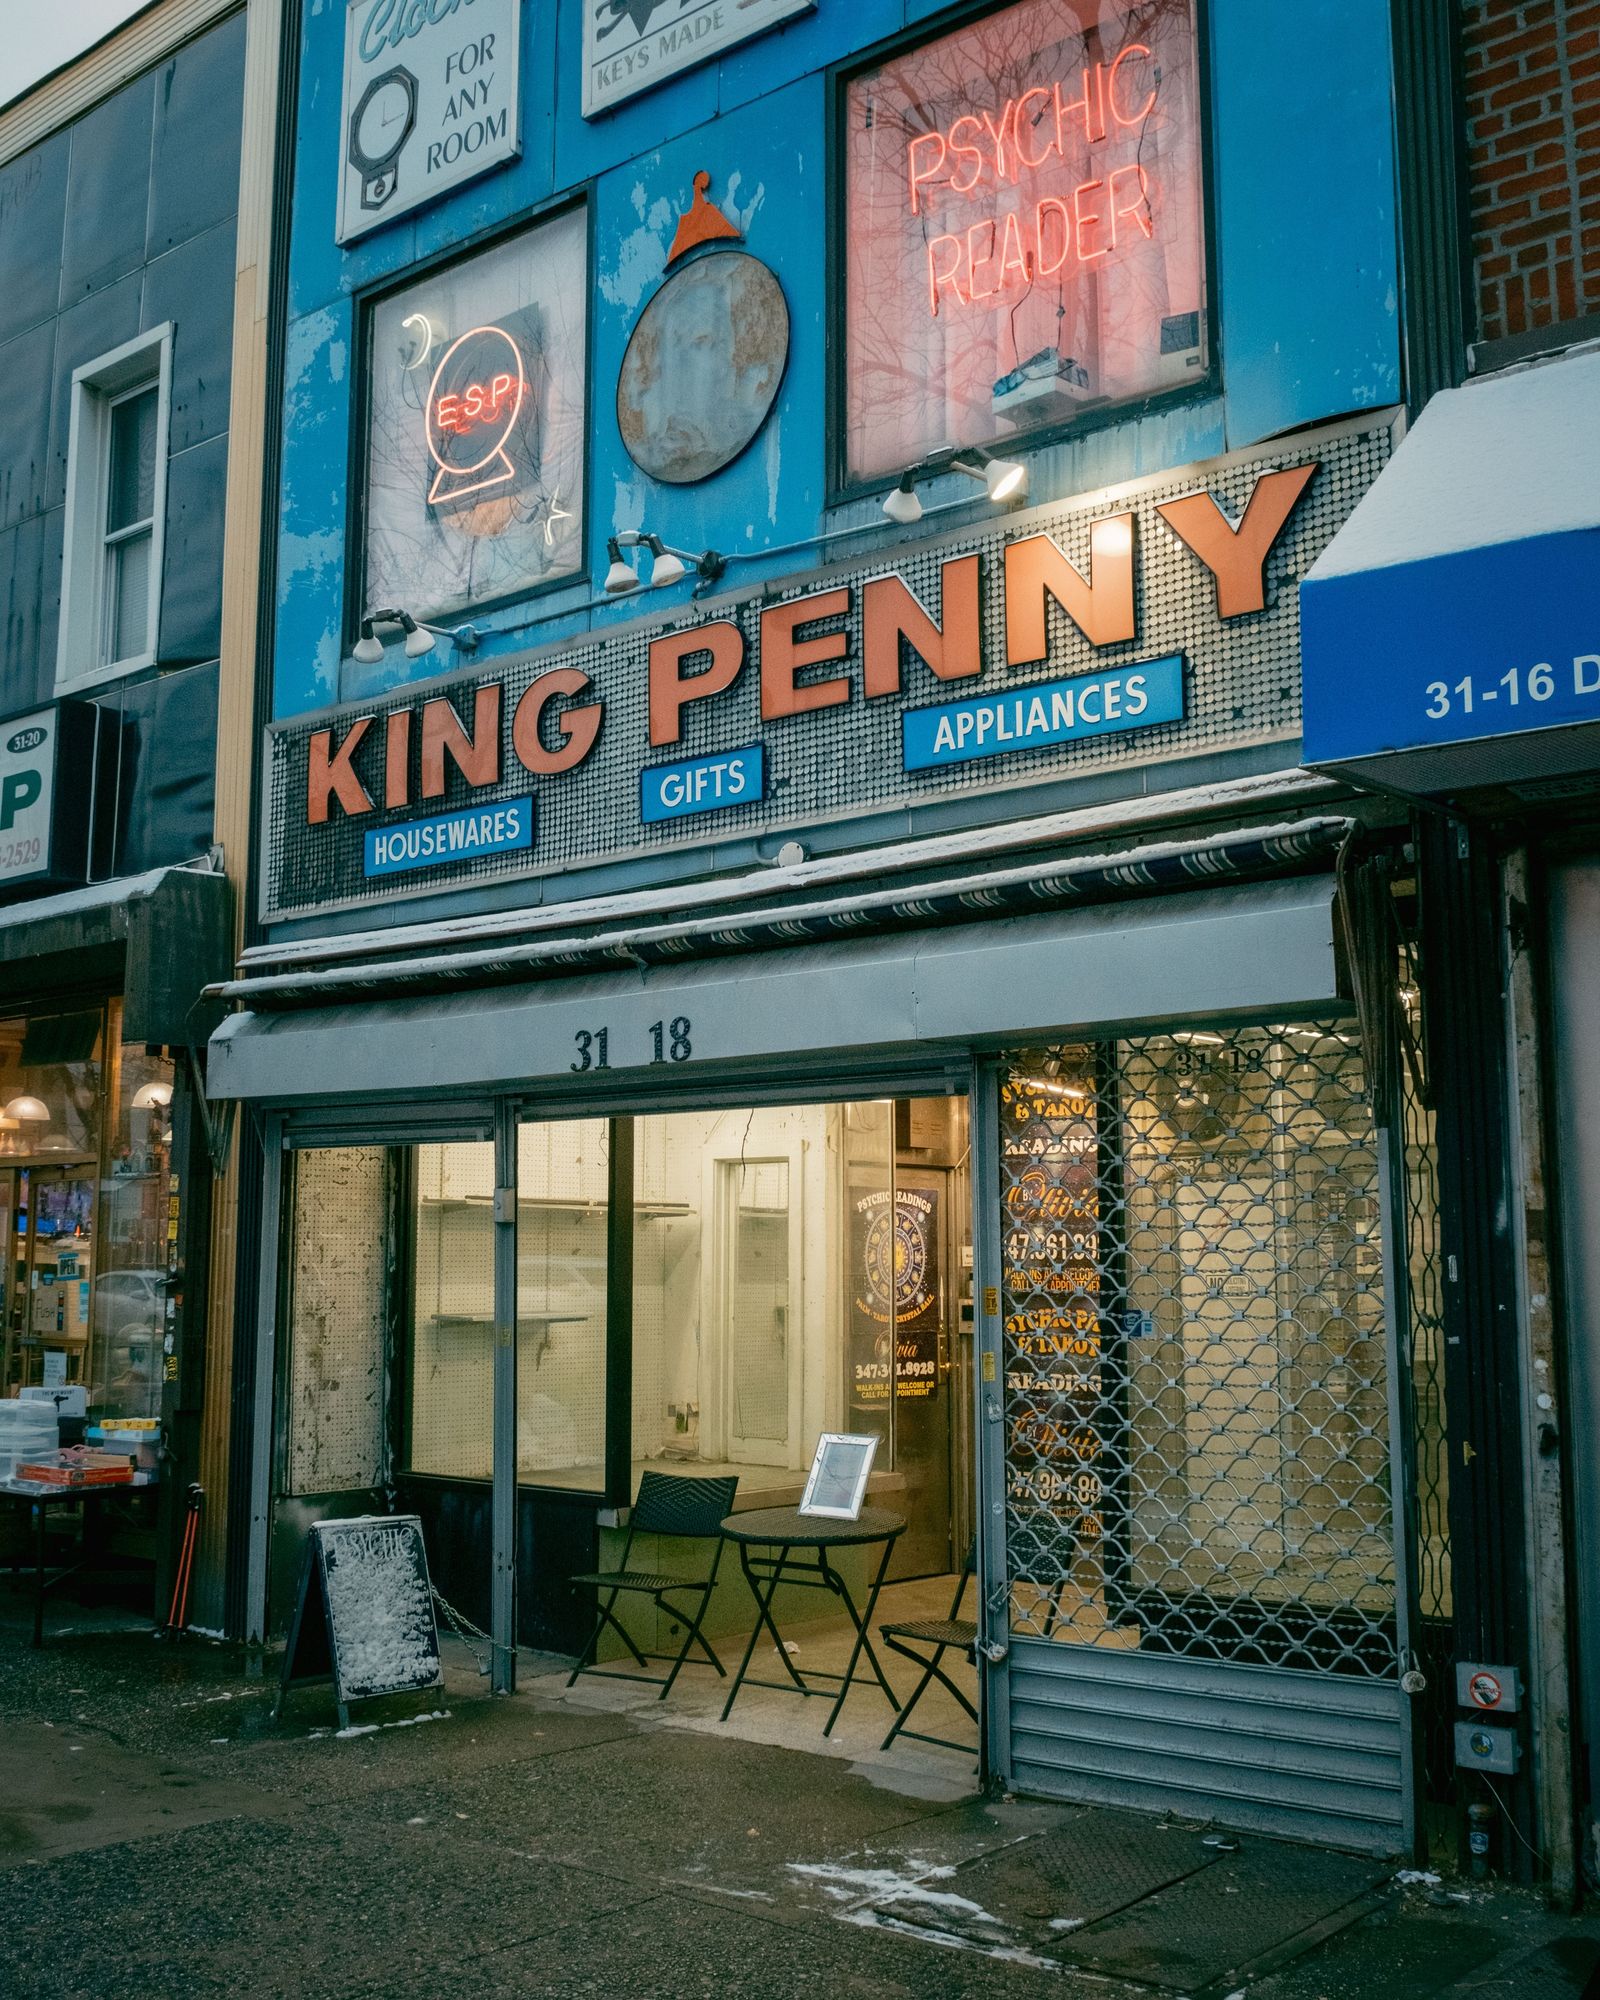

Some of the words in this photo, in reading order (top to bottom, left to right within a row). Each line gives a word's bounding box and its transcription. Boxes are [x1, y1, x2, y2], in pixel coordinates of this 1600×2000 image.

[445, 33, 496, 85] FOR
[597, 44, 650, 90] KEYS
[658, 6, 725, 59] MADE
[441, 72, 496, 127] ANY
[425, 108, 508, 174] ROOM
[908, 44, 1157, 217] PSYCHIC
[928, 164, 1154, 317] READER
[437, 374, 511, 427] ESP
[306, 665, 602, 825] KING
[648, 463, 1321, 748] PENNY
[932, 674, 1149, 754] APPLIANCES
[1425, 662, 1555, 719] 31-16
[14, 730, 41, 751] 31-20
[659, 758, 746, 809] GIFTS
[374, 807, 521, 866] HOUSEWARES
[570, 1026, 612, 1072] 31
[648, 1016, 692, 1065] 18
[856, 1191, 891, 1213] PSYCHIC
[895, 1191, 932, 1214] EADINGS
[873, 1312, 889, 1323] TARO
[855, 1360, 935, 1379] 347.31.8928
[861, 1391, 876, 1399] CALL
[897, 1381, 926, 1389] WELCOME
[331, 1527, 416, 1565] PSYCHIC
